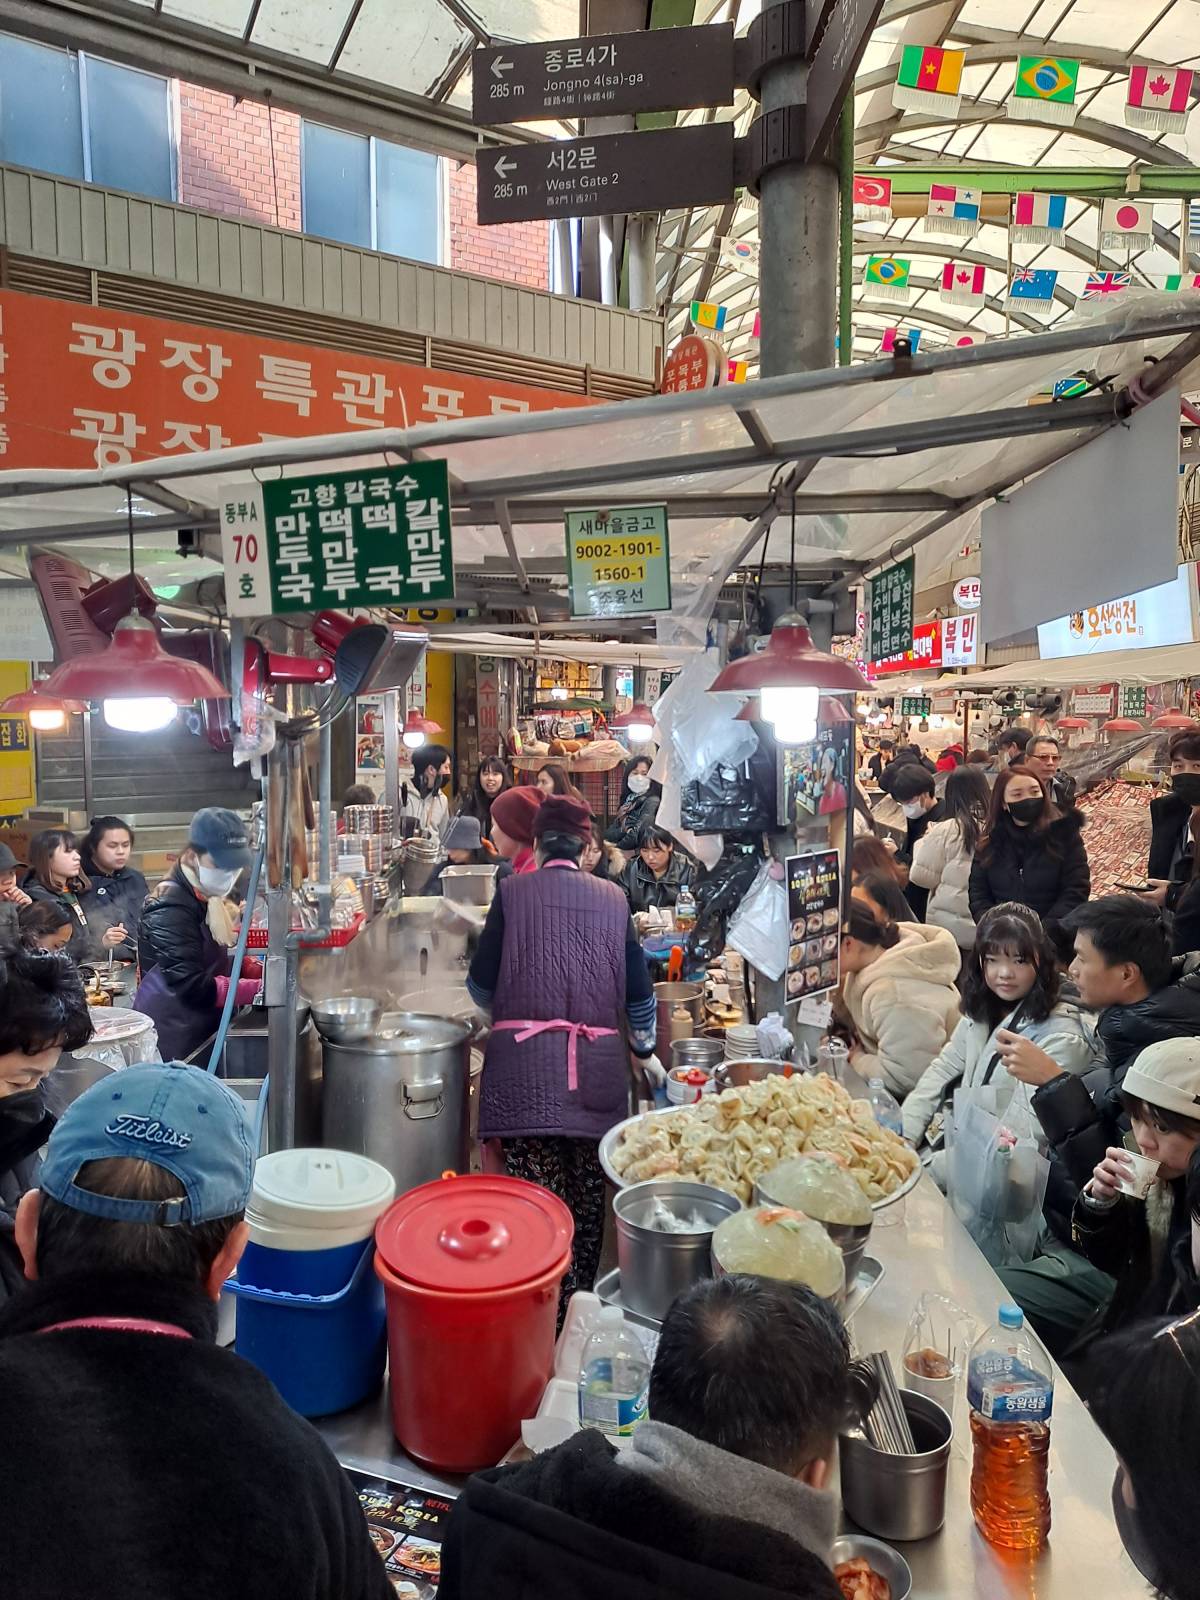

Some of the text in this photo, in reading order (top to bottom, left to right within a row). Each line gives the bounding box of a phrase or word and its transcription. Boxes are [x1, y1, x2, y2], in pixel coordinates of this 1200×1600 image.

[543, 44, 617, 73] 종로4가
[490, 83, 525, 98] 285 m
[543, 73, 644, 92] Jongno 4(sa)-ga
[547, 146, 597, 172] 서2문
[494, 183, 528, 198] 285 m
[546, 173, 619, 191] West Gate 2
[290, 475, 420, 508] 고향 칼국수
[578, 516, 656, 535] 새마을금고
[232, 534, 258, 564] 70
[275, 511, 316, 604] 만두국
[318, 507, 361, 601] 떡만두
[362, 502, 404, 597] 떡국
[405, 497, 446, 594] 칼만두
[576, 541, 661, 559] 9002-1901-
[238, 573, 256, 599] 호
[595, 566, 644, 581] 1560-1
[872, 598, 881, 656] 수제비
[1087, 600, 1136, 638] 오선생전
[945, 616, 975, 654] 복민
[105, 1113, 192, 1149] Titleist
[1004, 1396, 1046, 1410] 동원샘물
[396, 1505, 439, 1523] KOREA
